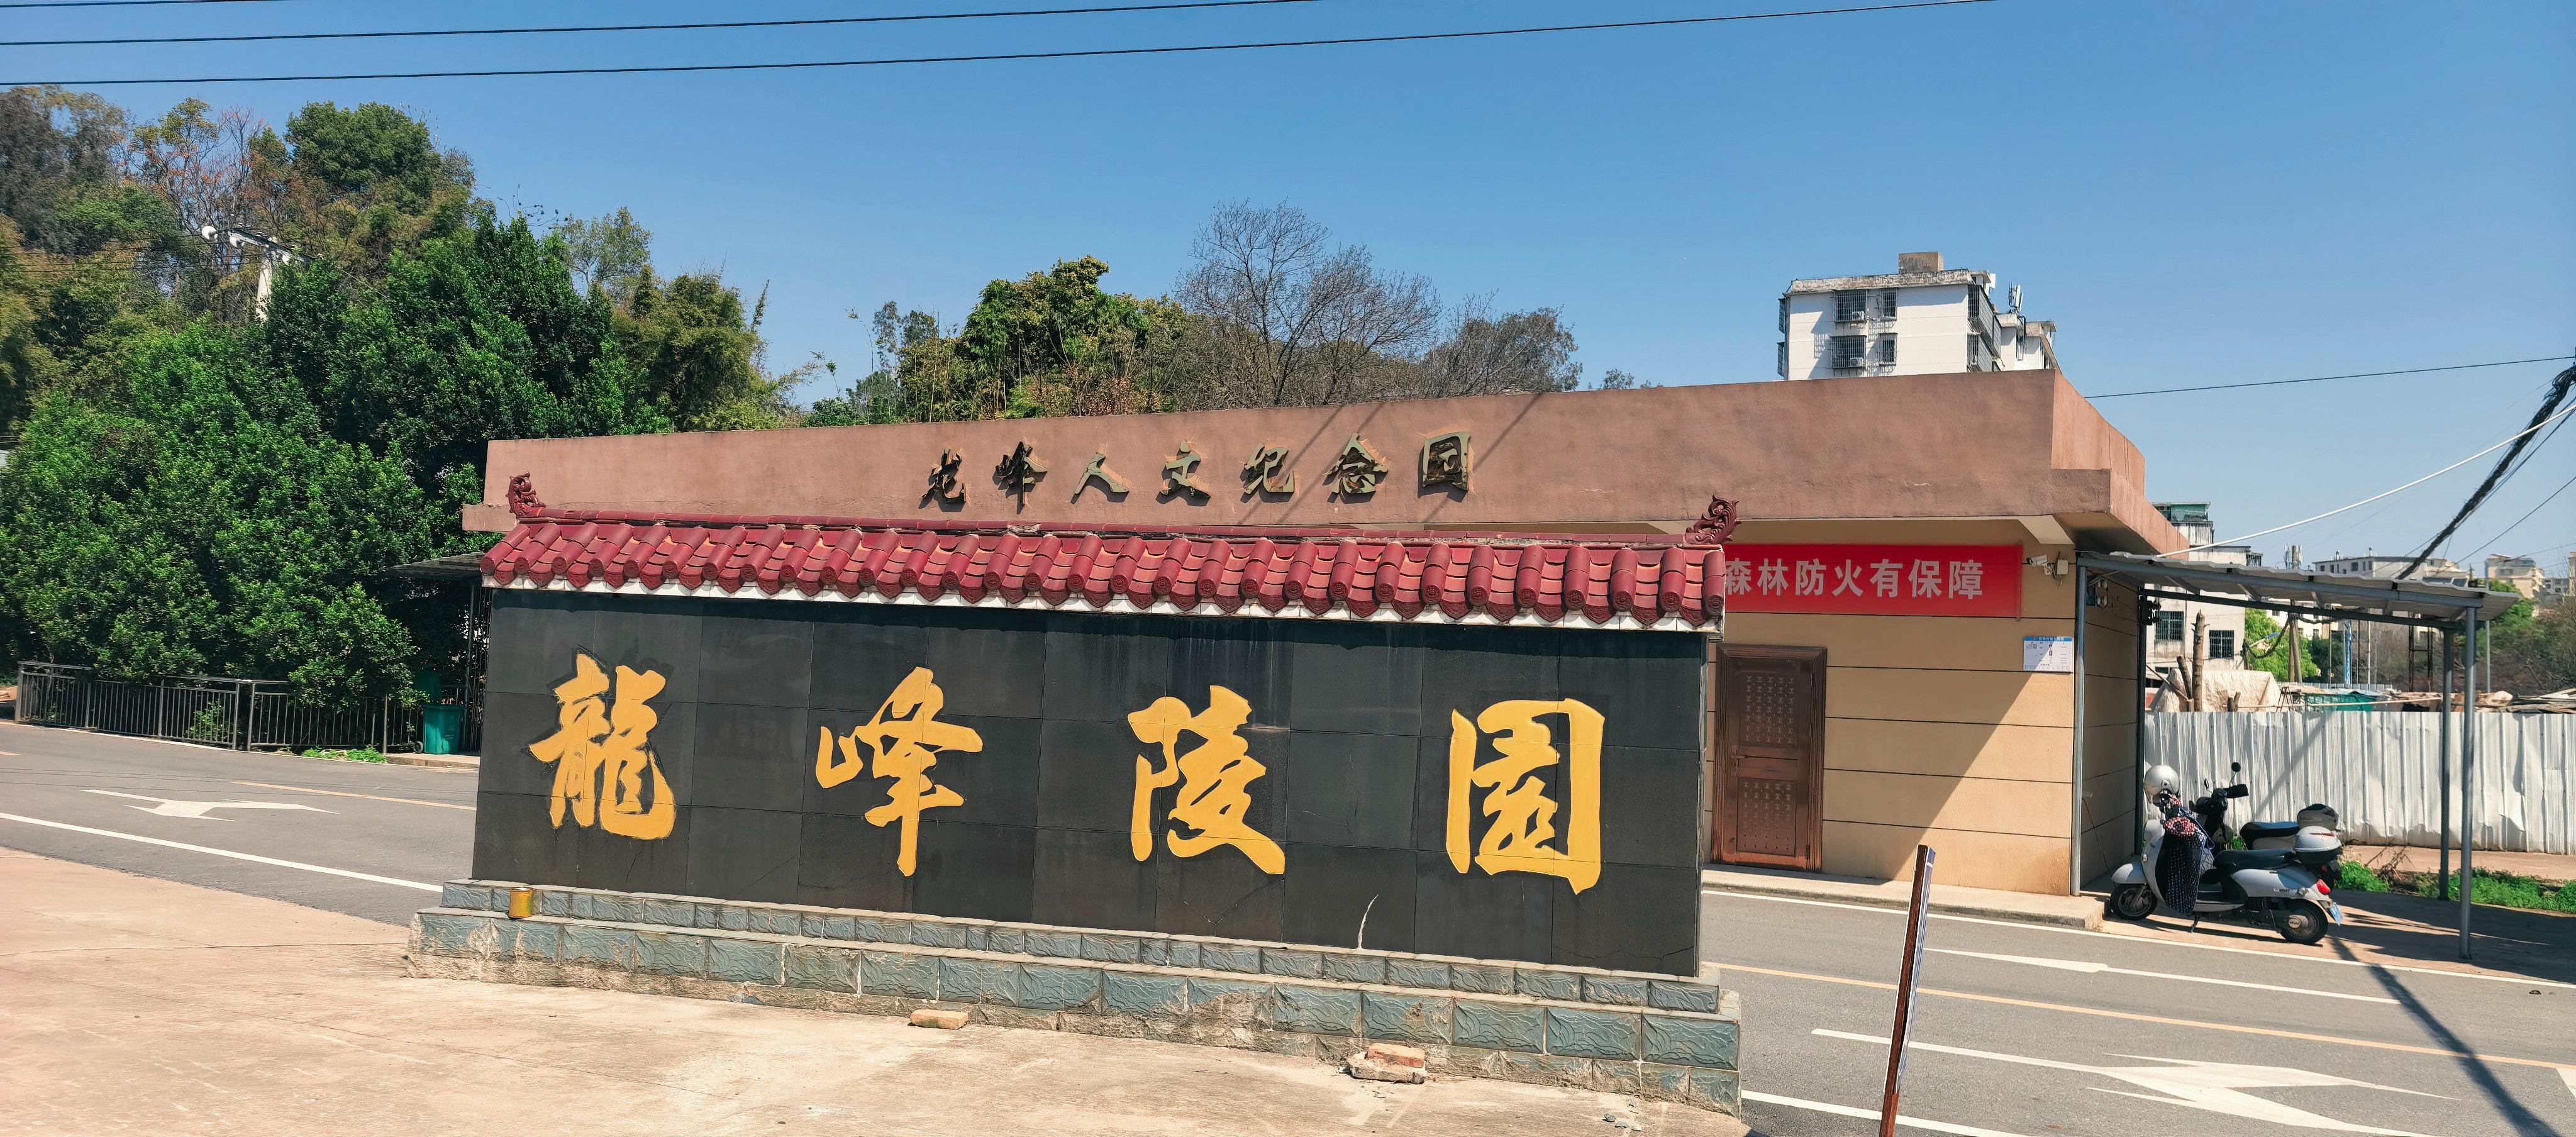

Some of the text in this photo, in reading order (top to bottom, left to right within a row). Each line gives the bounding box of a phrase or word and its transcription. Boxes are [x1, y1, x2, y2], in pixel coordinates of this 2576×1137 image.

[1725, 557, 1984, 599] 森林防火有保障
